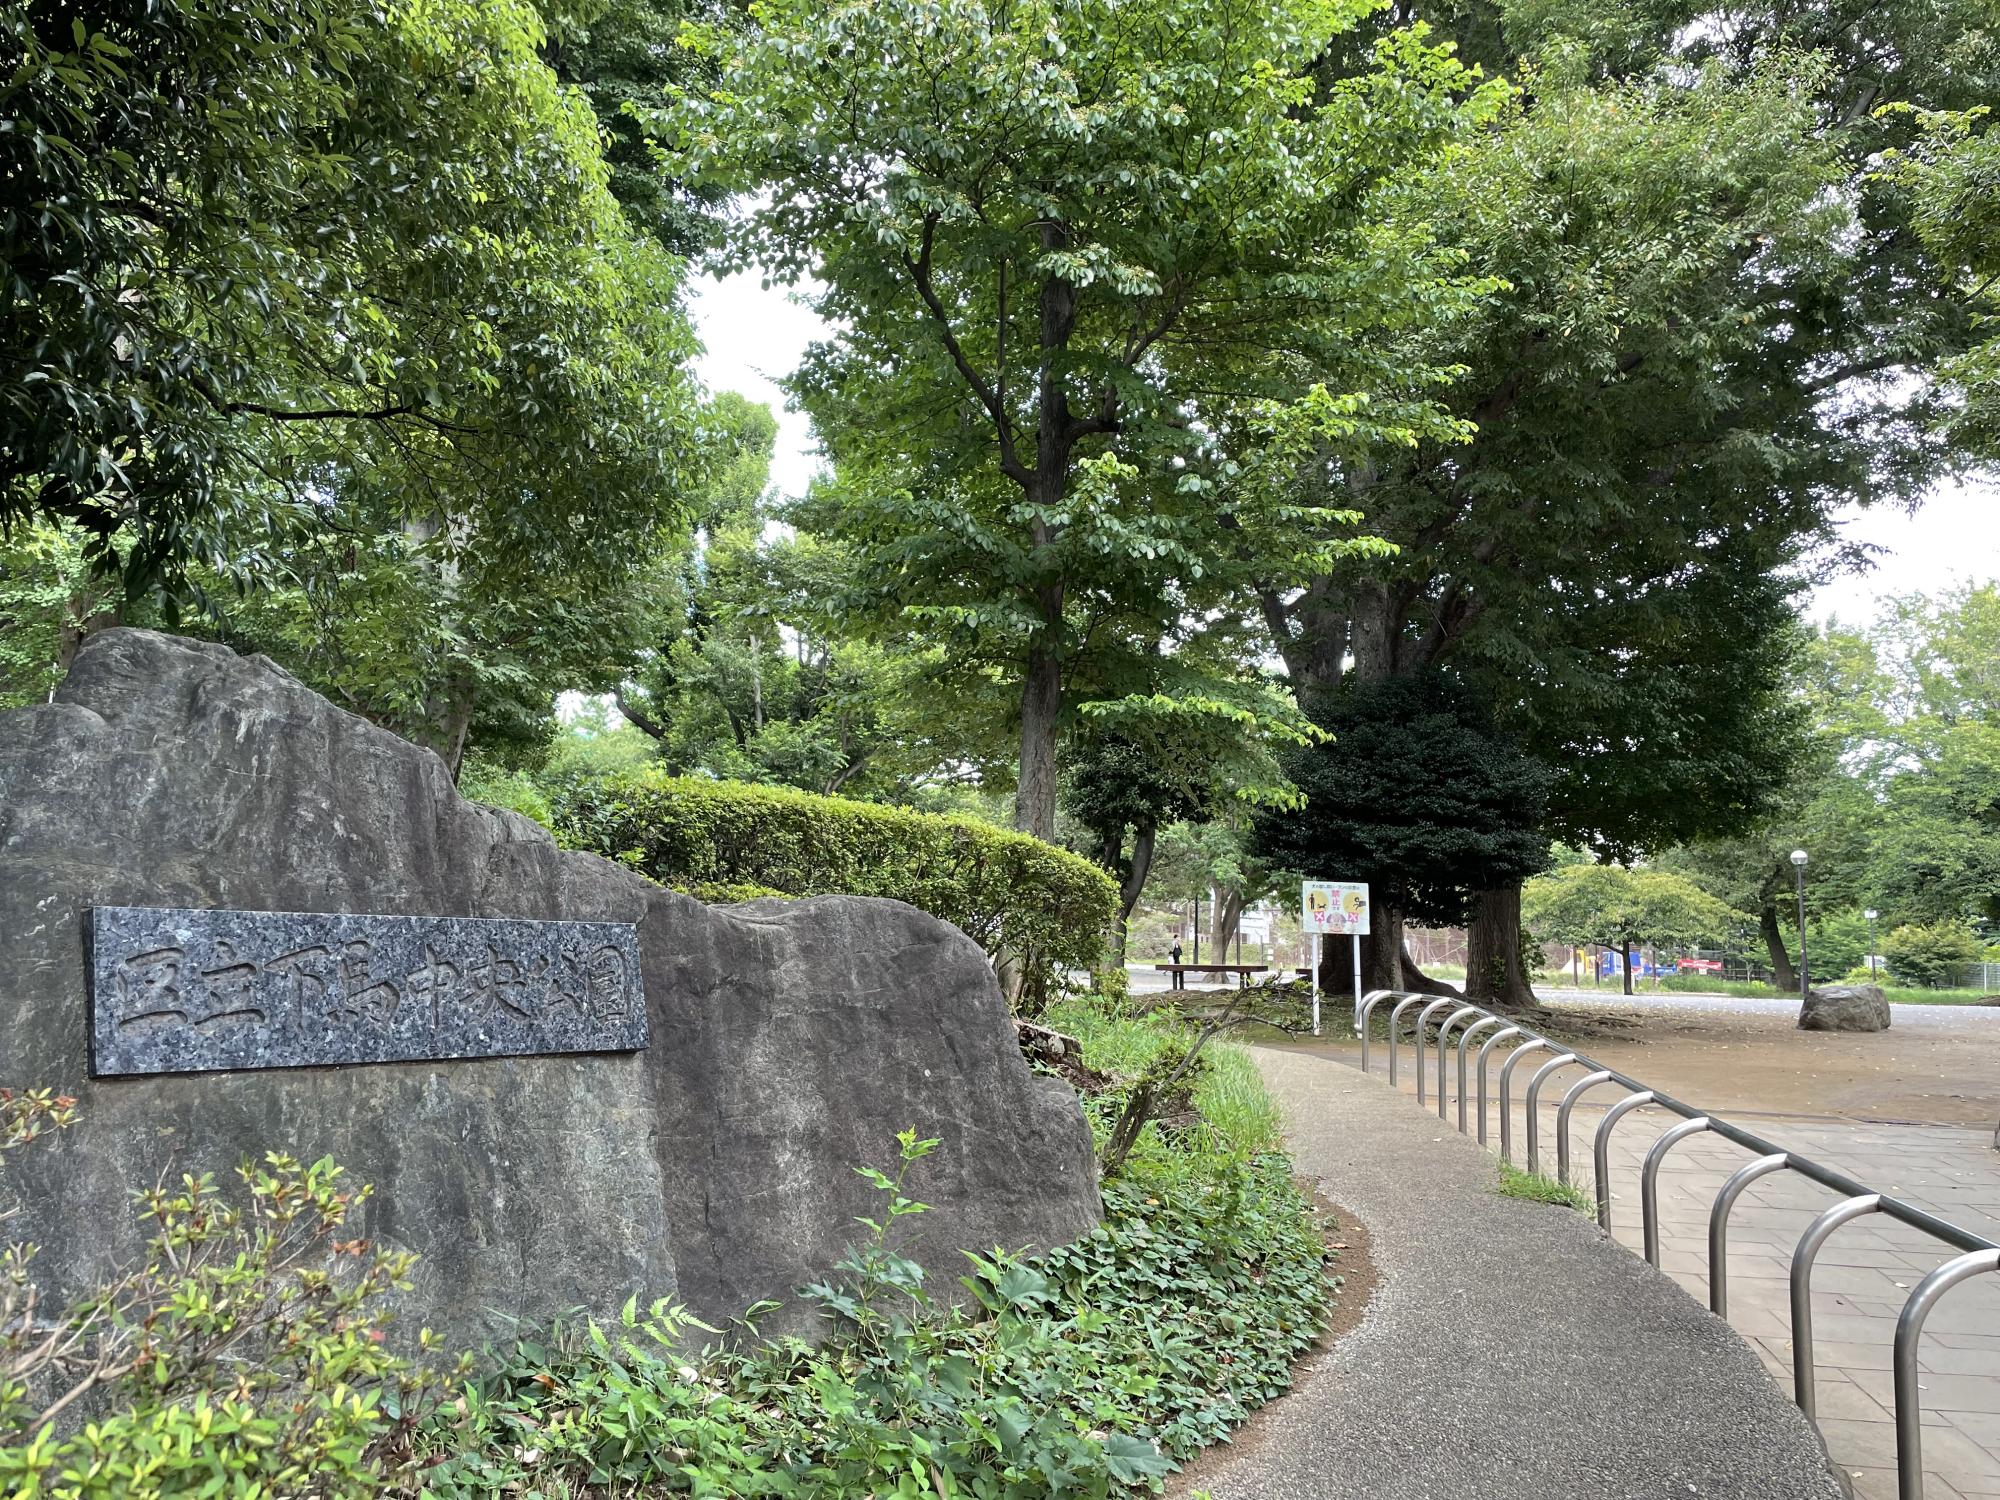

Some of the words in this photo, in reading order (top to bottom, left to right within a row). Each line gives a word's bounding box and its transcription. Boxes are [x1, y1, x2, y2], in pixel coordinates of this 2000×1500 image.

[116, 939, 632, 1033] 区立下馬中央公園
